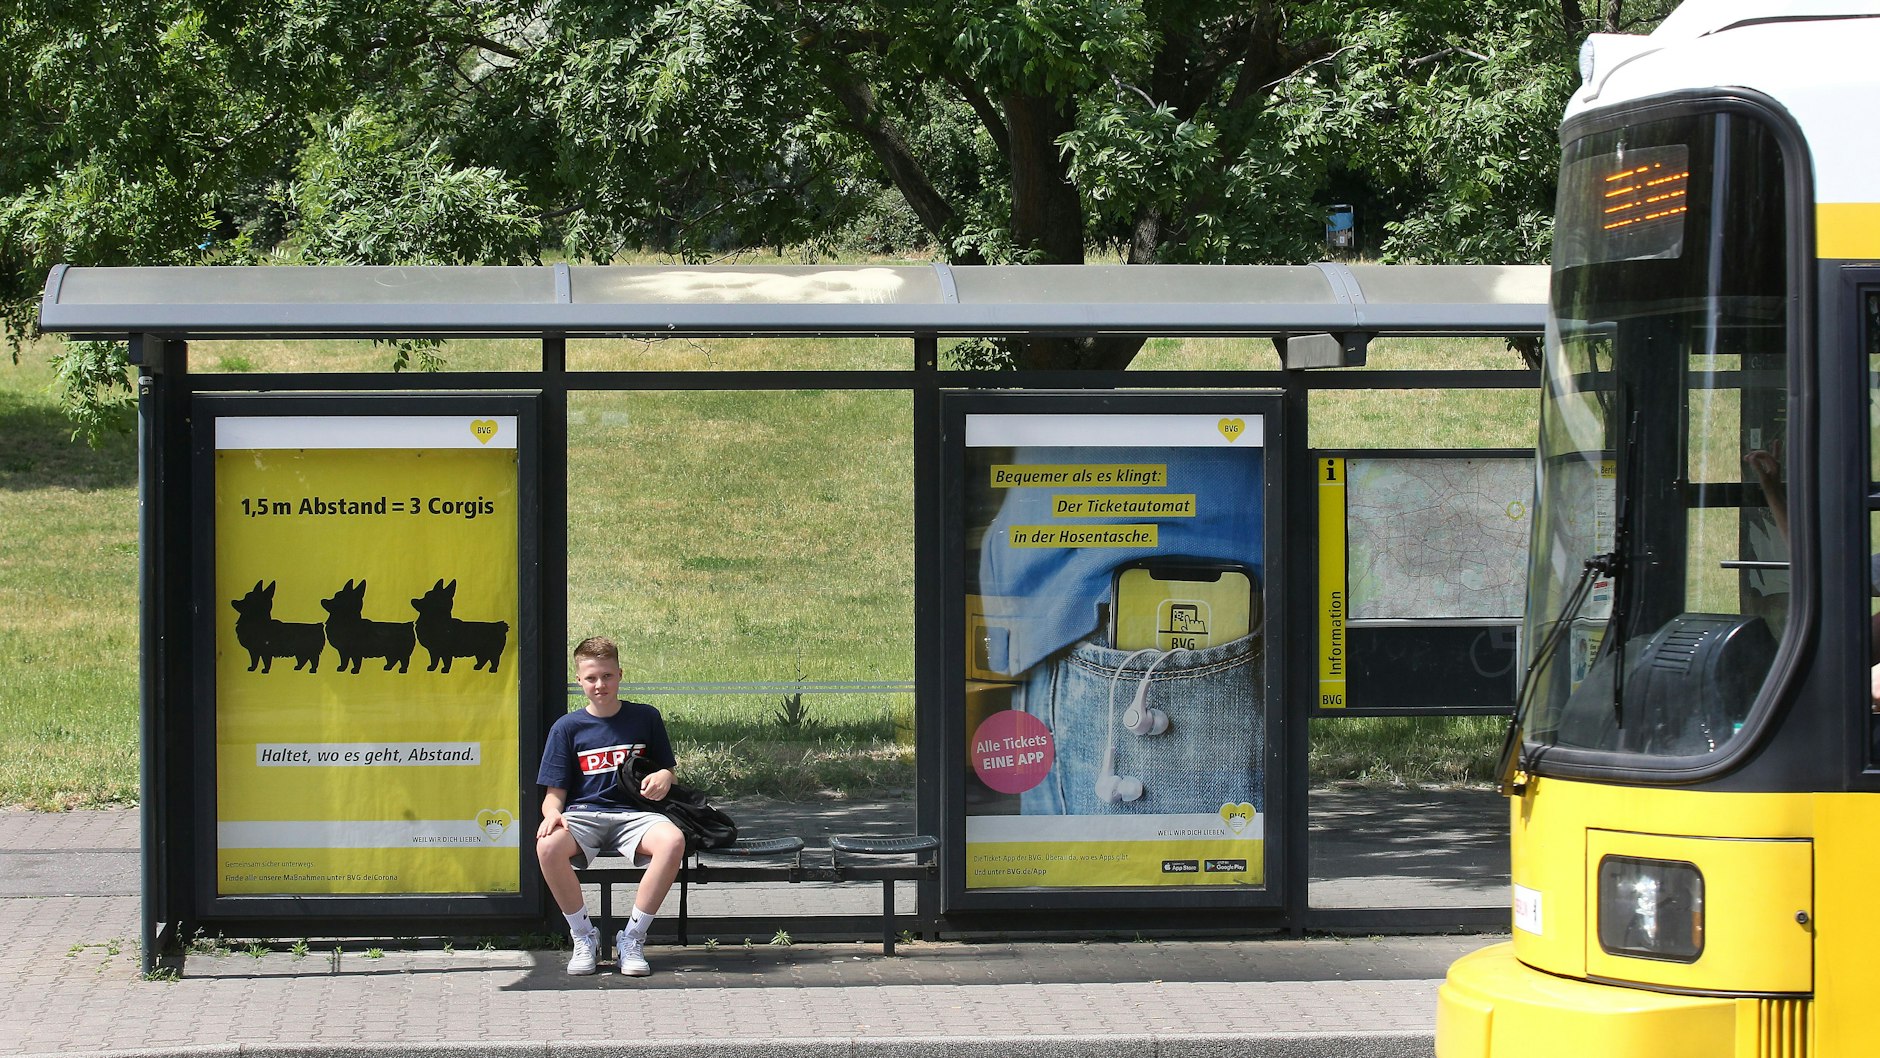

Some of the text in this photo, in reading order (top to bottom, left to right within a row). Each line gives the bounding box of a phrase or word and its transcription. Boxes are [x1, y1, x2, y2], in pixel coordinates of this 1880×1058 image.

[477, 426, 492, 434] BVG
[1224, 424, 1239, 433] BVG
[996, 469, 1161, 486] Bequemer als es klingt:
[240, 496, 494, 519] 1,5 m Abstand = 3 Corgis
[1057, 499, 1190, 513] Der Ticketautomat
[1014, 529, 1153, 543] in der Hosentasche.
[1328, 591, 1342, 675] Information
[1171, 637, 1195, 650] BVG
[1322, 694, 1342, 705] BVG
[976, 735, 1047, 753] Alle Tickets
[261, 747, 475, 765] Haltet, wo es geht, Abstand.
[982, 751, 1044, 770] EINE APP
[225, 860, 261, 868] Gemeinsam
[261, 860, 280, 868] sicher
[983, 854, 1015, 863] Ticket-App
[1099, 854, 1115, 862] Apps
[225, 874, 243, 882] Finde
[283, 873, 326, 881] Maßnahmen
[974, 867, 1047, 876] Und unter BVG.de/App
